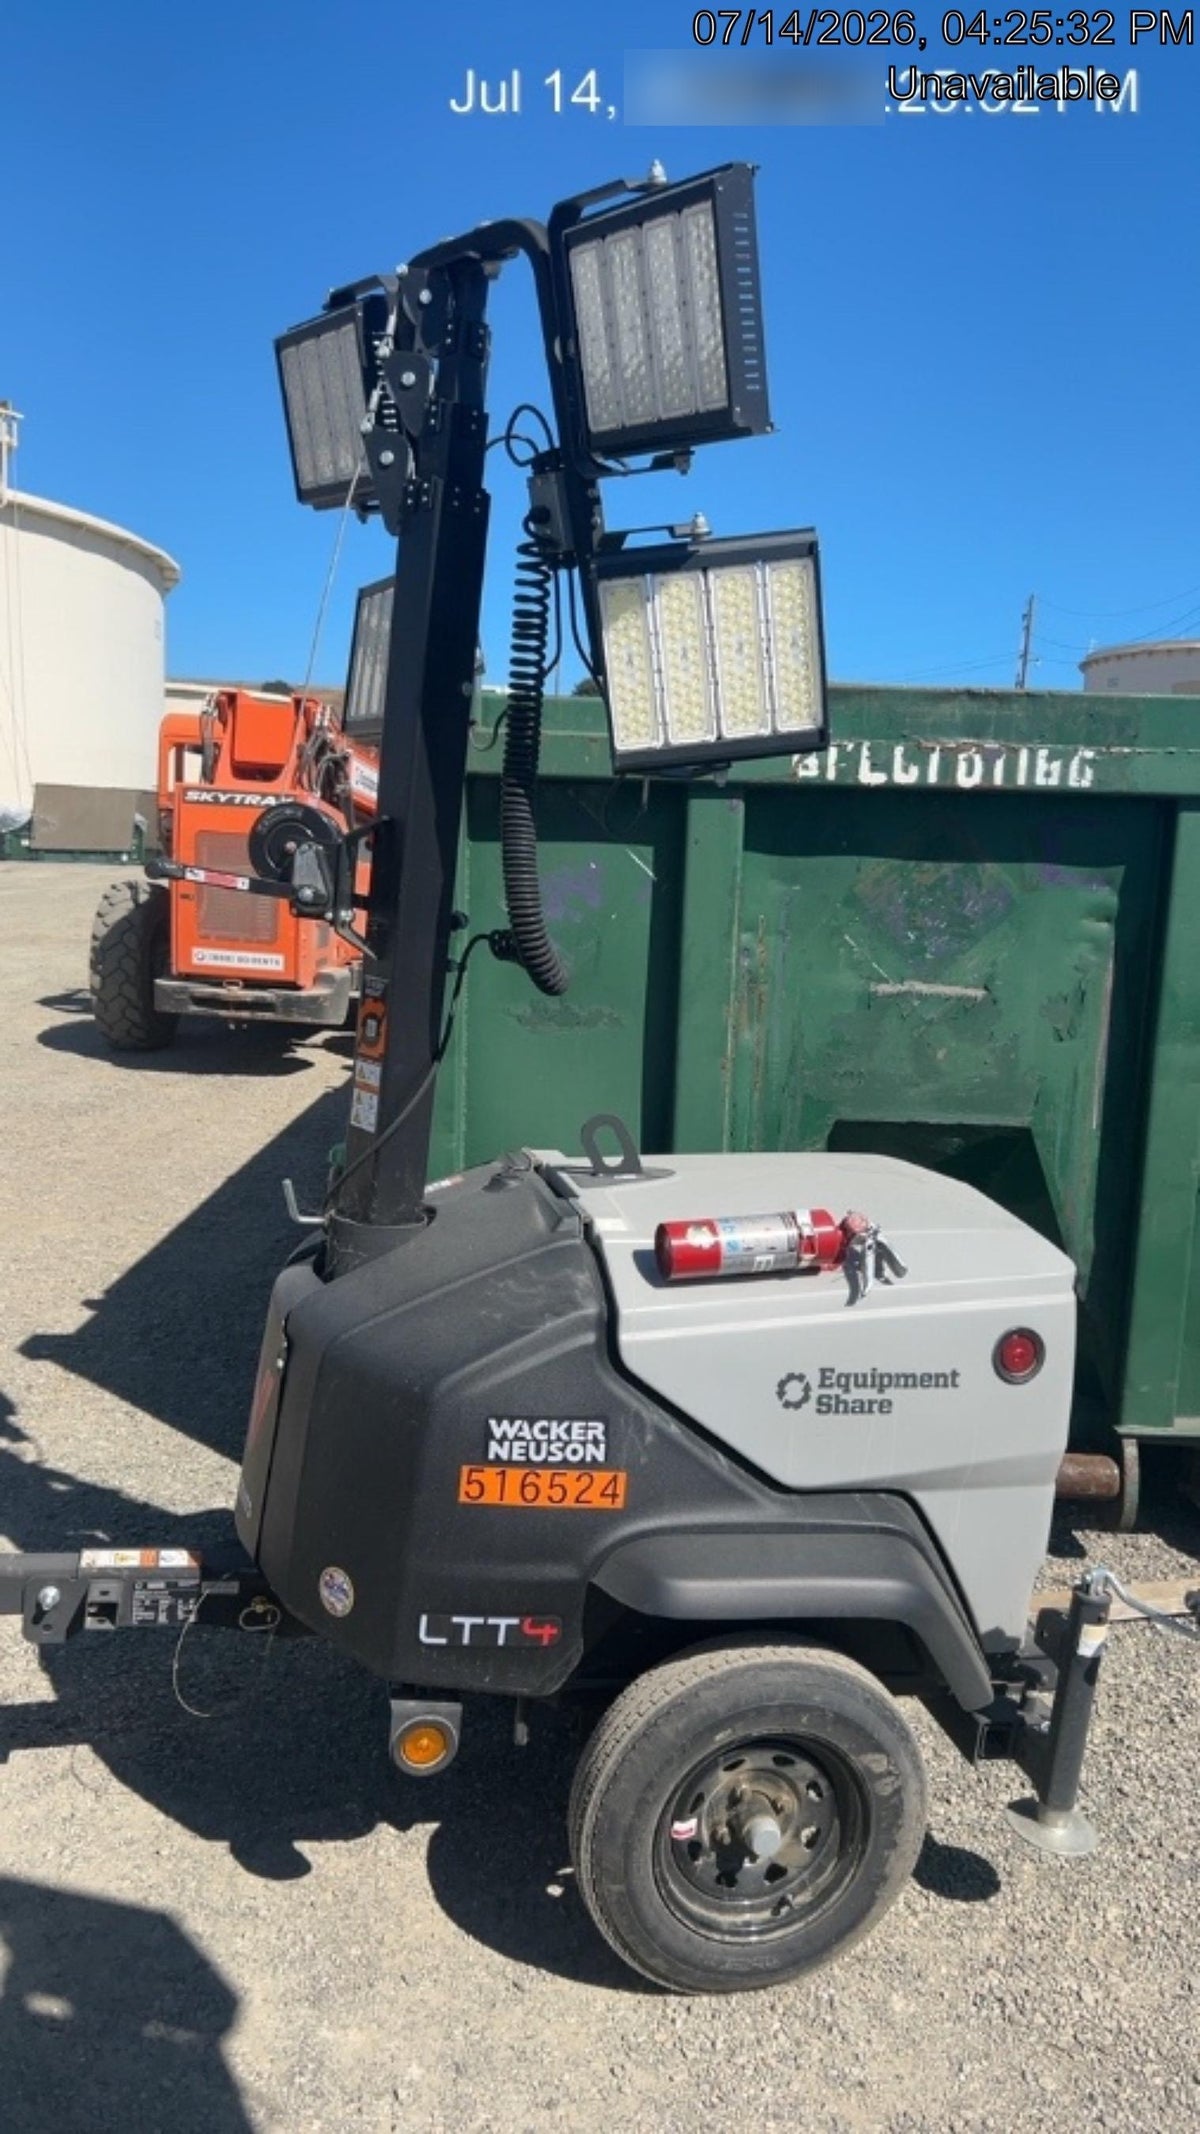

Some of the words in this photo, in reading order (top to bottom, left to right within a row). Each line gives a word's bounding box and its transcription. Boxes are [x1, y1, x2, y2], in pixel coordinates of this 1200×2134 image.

[817, 1367, 960, 1394] Equipment
[815, 1394, 893, 1415] Share
[487, 1418, 606, 1441] WACKER
[487, 1440, 606, 1463] NEUSON
[464, 1466, 621, 1506] 516524
[418, 1613, 558, 1647] LTT4
